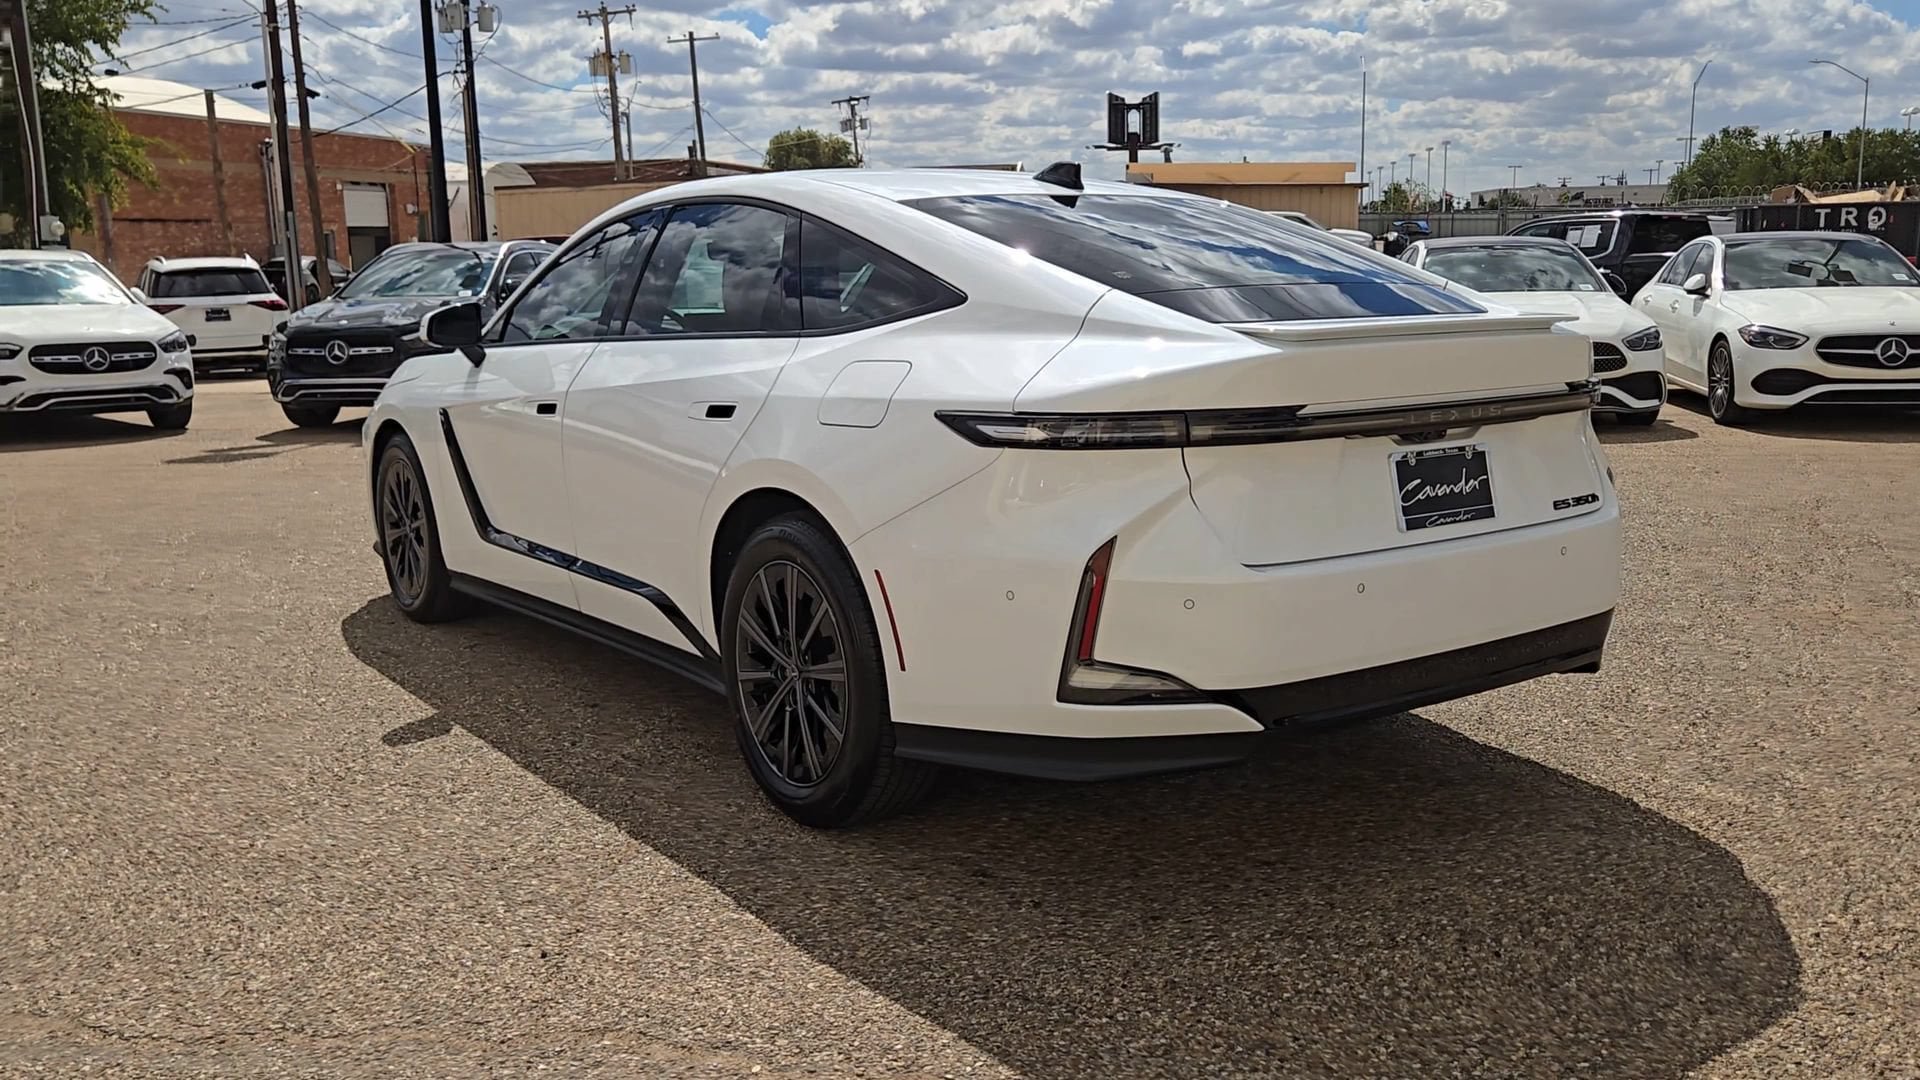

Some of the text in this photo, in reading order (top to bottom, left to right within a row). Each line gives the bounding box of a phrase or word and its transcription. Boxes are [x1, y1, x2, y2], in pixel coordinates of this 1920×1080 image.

[1410, 406, 1502, 424] LEXUS
[1400, 467, 1488, 506] Cavender
[1425, 510, 1477, 528] Cavender
